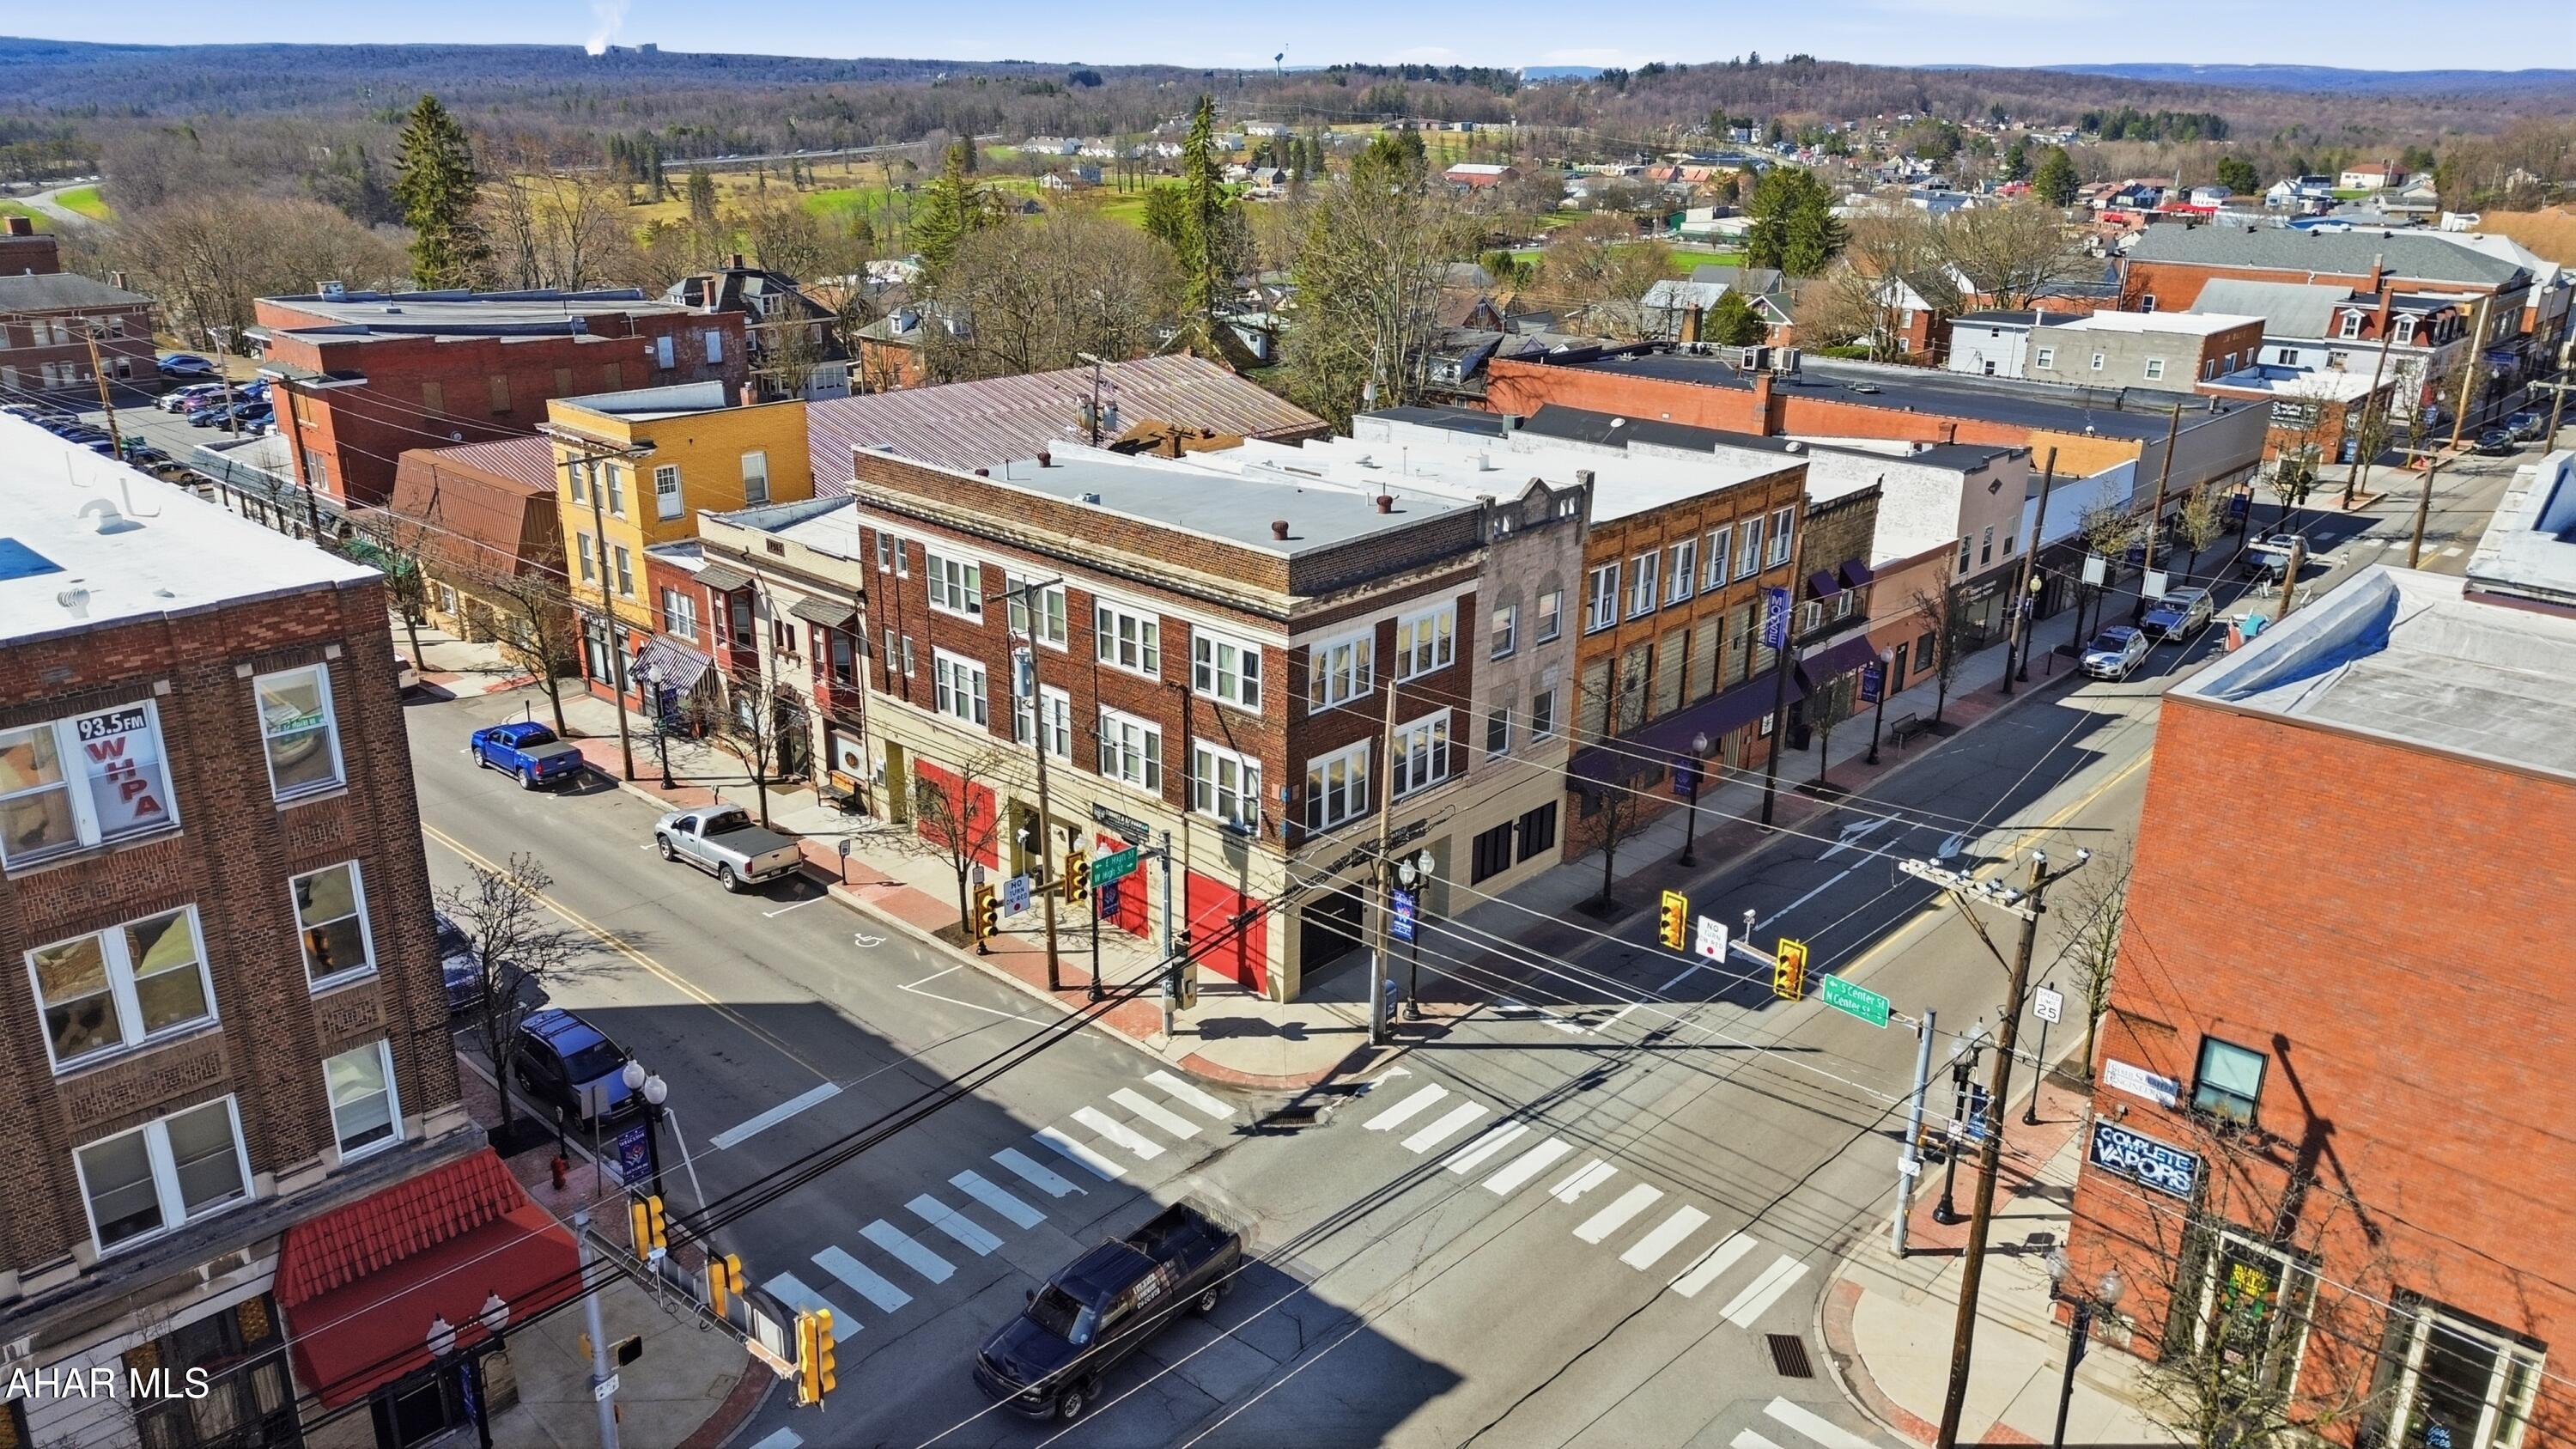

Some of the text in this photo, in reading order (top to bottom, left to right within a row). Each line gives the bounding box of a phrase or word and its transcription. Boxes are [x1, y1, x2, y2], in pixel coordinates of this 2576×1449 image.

[1769, 595, 1783, 644] MOOSE
[1011, 880, 1022, 889] NO
[1094, 874, 1101, 883] W
[1005, 892, 1028, 906] ON RED
[1009, 886, 1024, 898] TURN
[1704, 929, 1721, 941] TURN
[1707, 922, 1719, 933] NO
[1826, 990, 1870, 1017] N Center St
[1841, 983, 1886, 1010] S Center St
[2037, 1003, 2057, 1020] 25
[2100, 1127, 2193, 1171] COMPLETE
[2095, 1137, 2191, 1191] VAPORS
